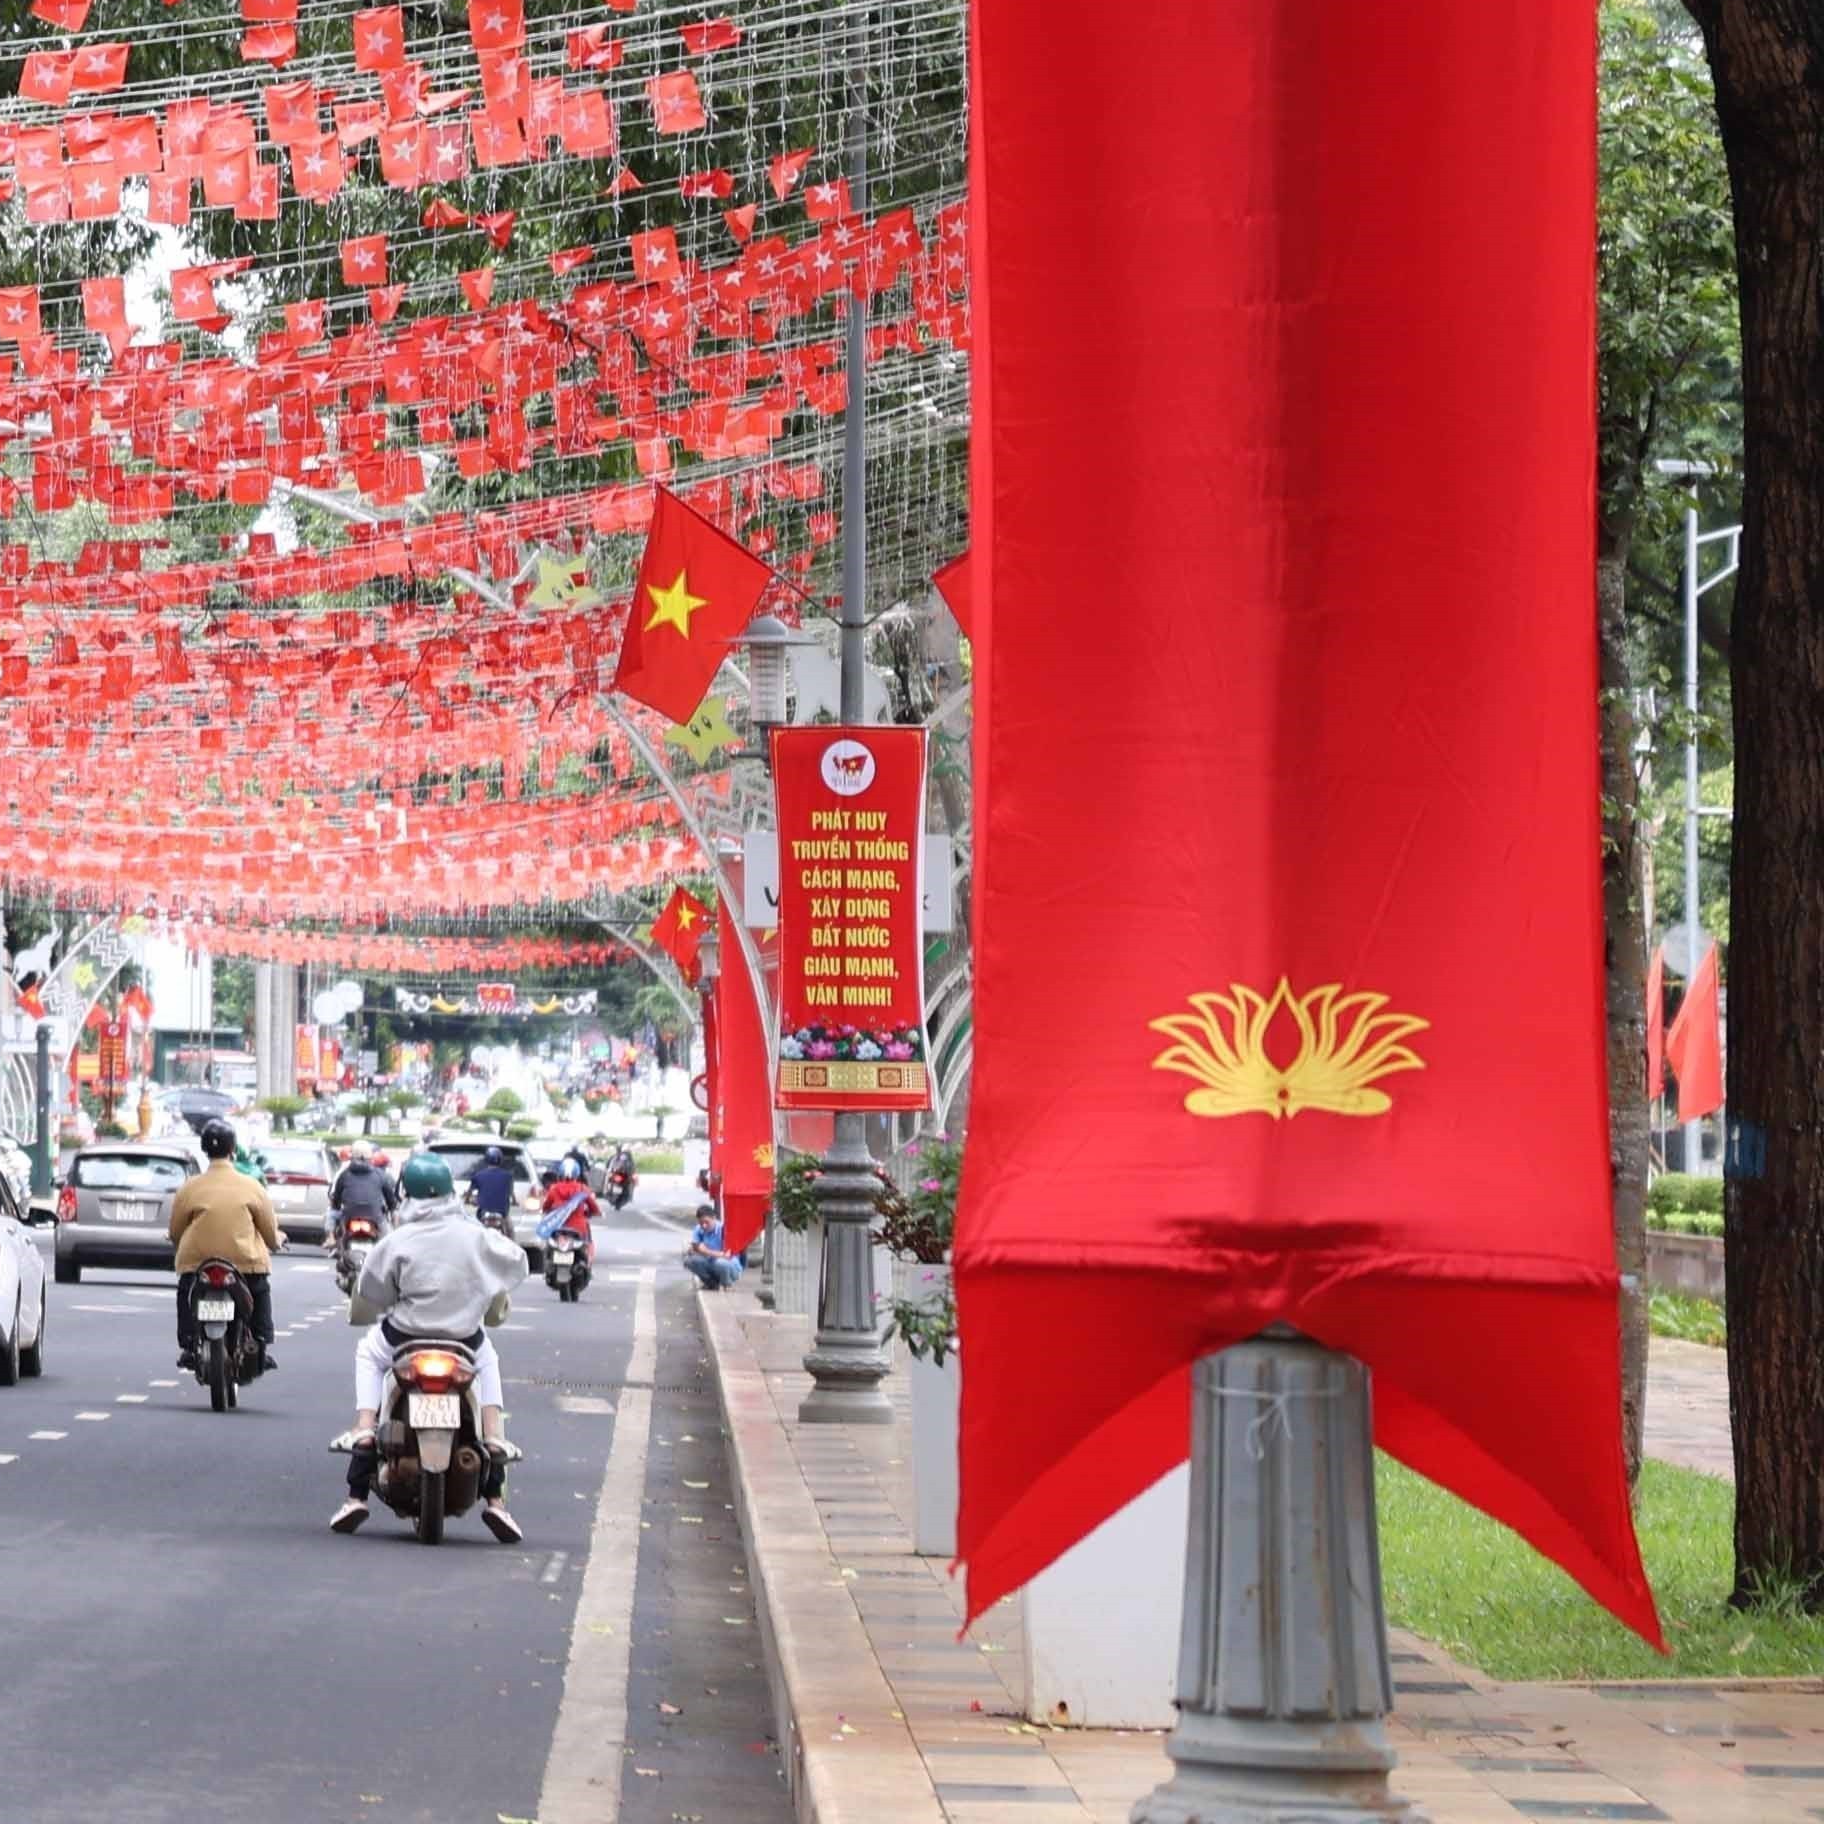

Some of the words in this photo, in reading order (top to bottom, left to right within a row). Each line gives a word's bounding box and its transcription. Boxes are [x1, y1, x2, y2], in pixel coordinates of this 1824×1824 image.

[812, 807, 851, 831] PHÁT
[855, 811, 887, 831] HUY
[792, 834, 851, 860] TRUYỀN
[855, 834, 909, 861] THỐNG
[802, 866, 842, 889] CÁCH
[846, 869, 900, 892] MẠNG,
[811, 895, 840, 918] XÂY
[846, 897, 890, 922] DỰNG
[812, 921, 841, 947] ĐẤT
[846, 924, 890, 947] NƯỚC
[804, 954, 840, 977] GIÀU
[846, 956, 899, 981] MẠNH,
[806, 983, 838, 1005] VĂN
[843, 986, 892, 1006] MINH!
